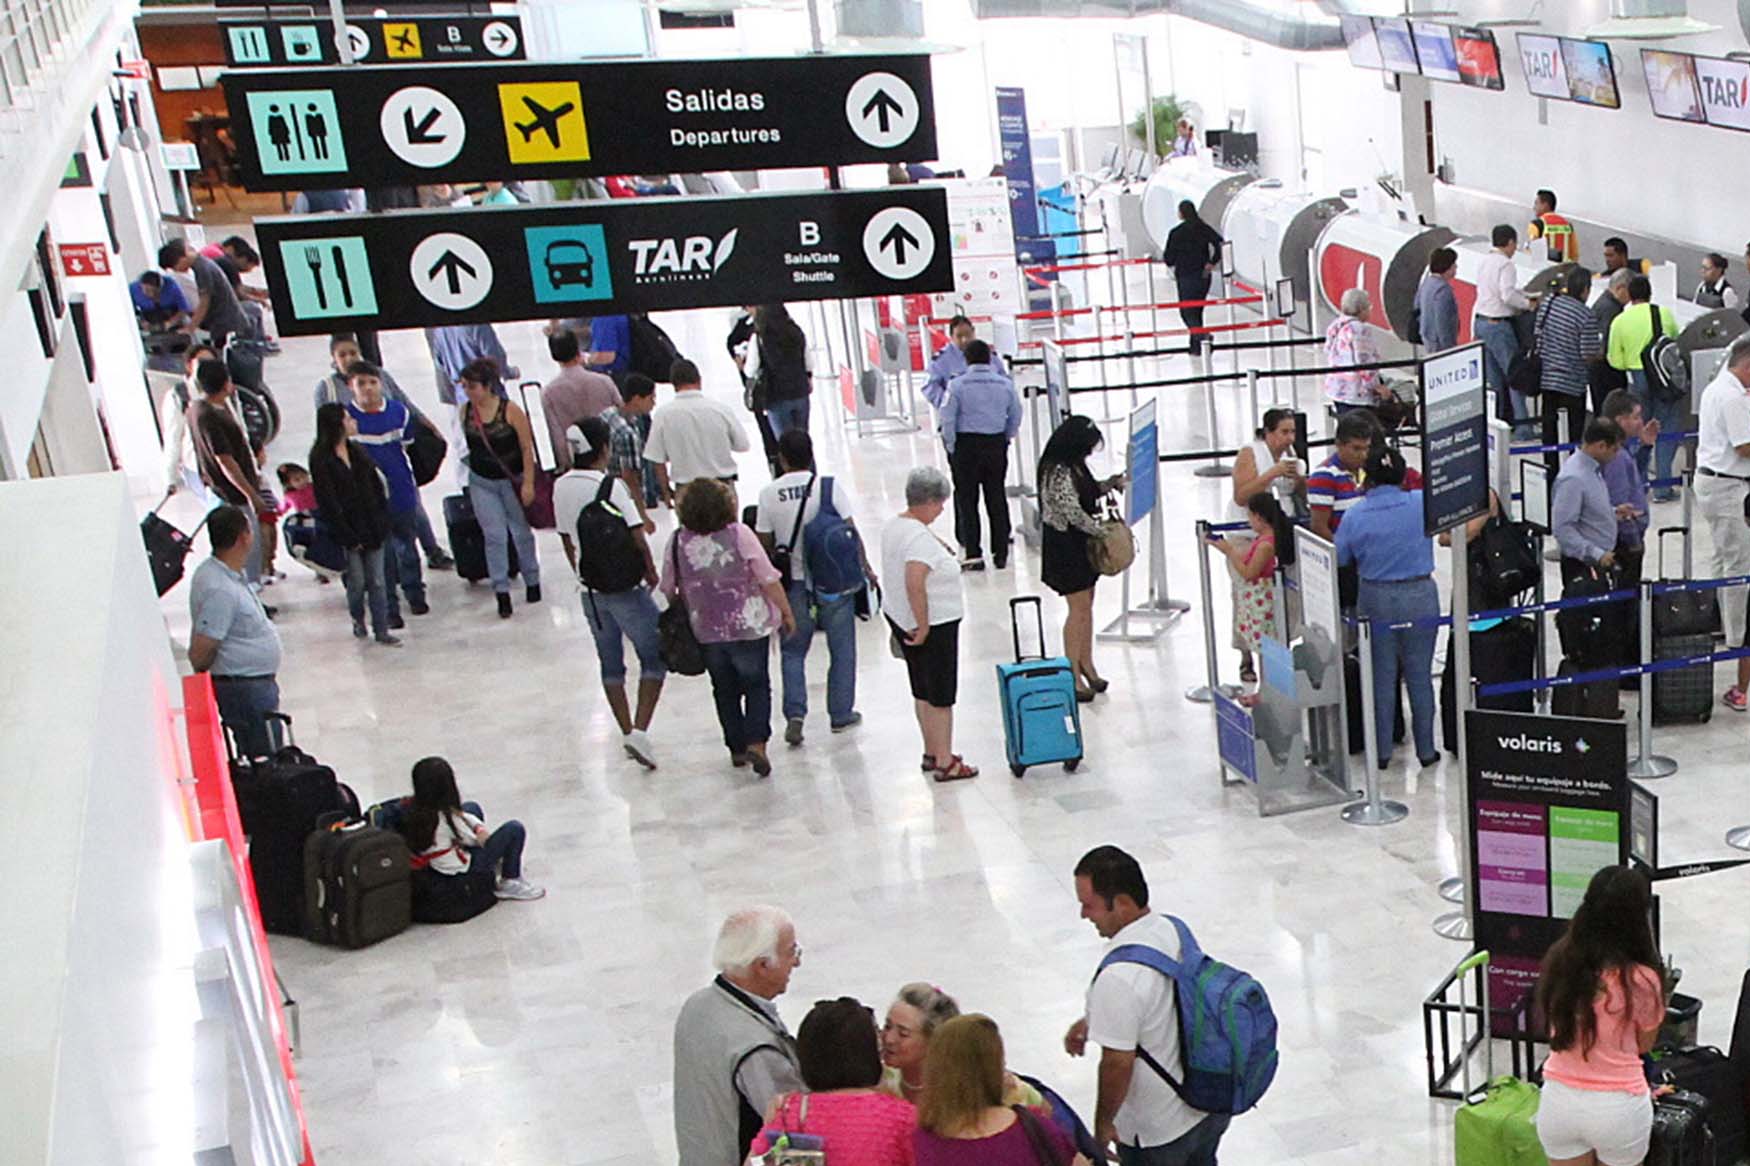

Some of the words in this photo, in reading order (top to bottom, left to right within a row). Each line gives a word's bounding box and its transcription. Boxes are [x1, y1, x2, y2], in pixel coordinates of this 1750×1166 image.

[446, 26, 461, 43] B
[1524, 51, 1551, 78] TAR
[665, 88, 765, 112] Salidas
[1702, 76, 1740, 108] TAR
[670, 128, 781, 148] Departures
[799, 221, 821, 246] B
[628, 236, 714, 275] TAR
[783, 252, 840, 265] Sala/Gate
[793, 270, 834, 283] Shuttle
[1429, 368, 1467, 390] UNITED
[1498, 733, 1562, 754] volaris
